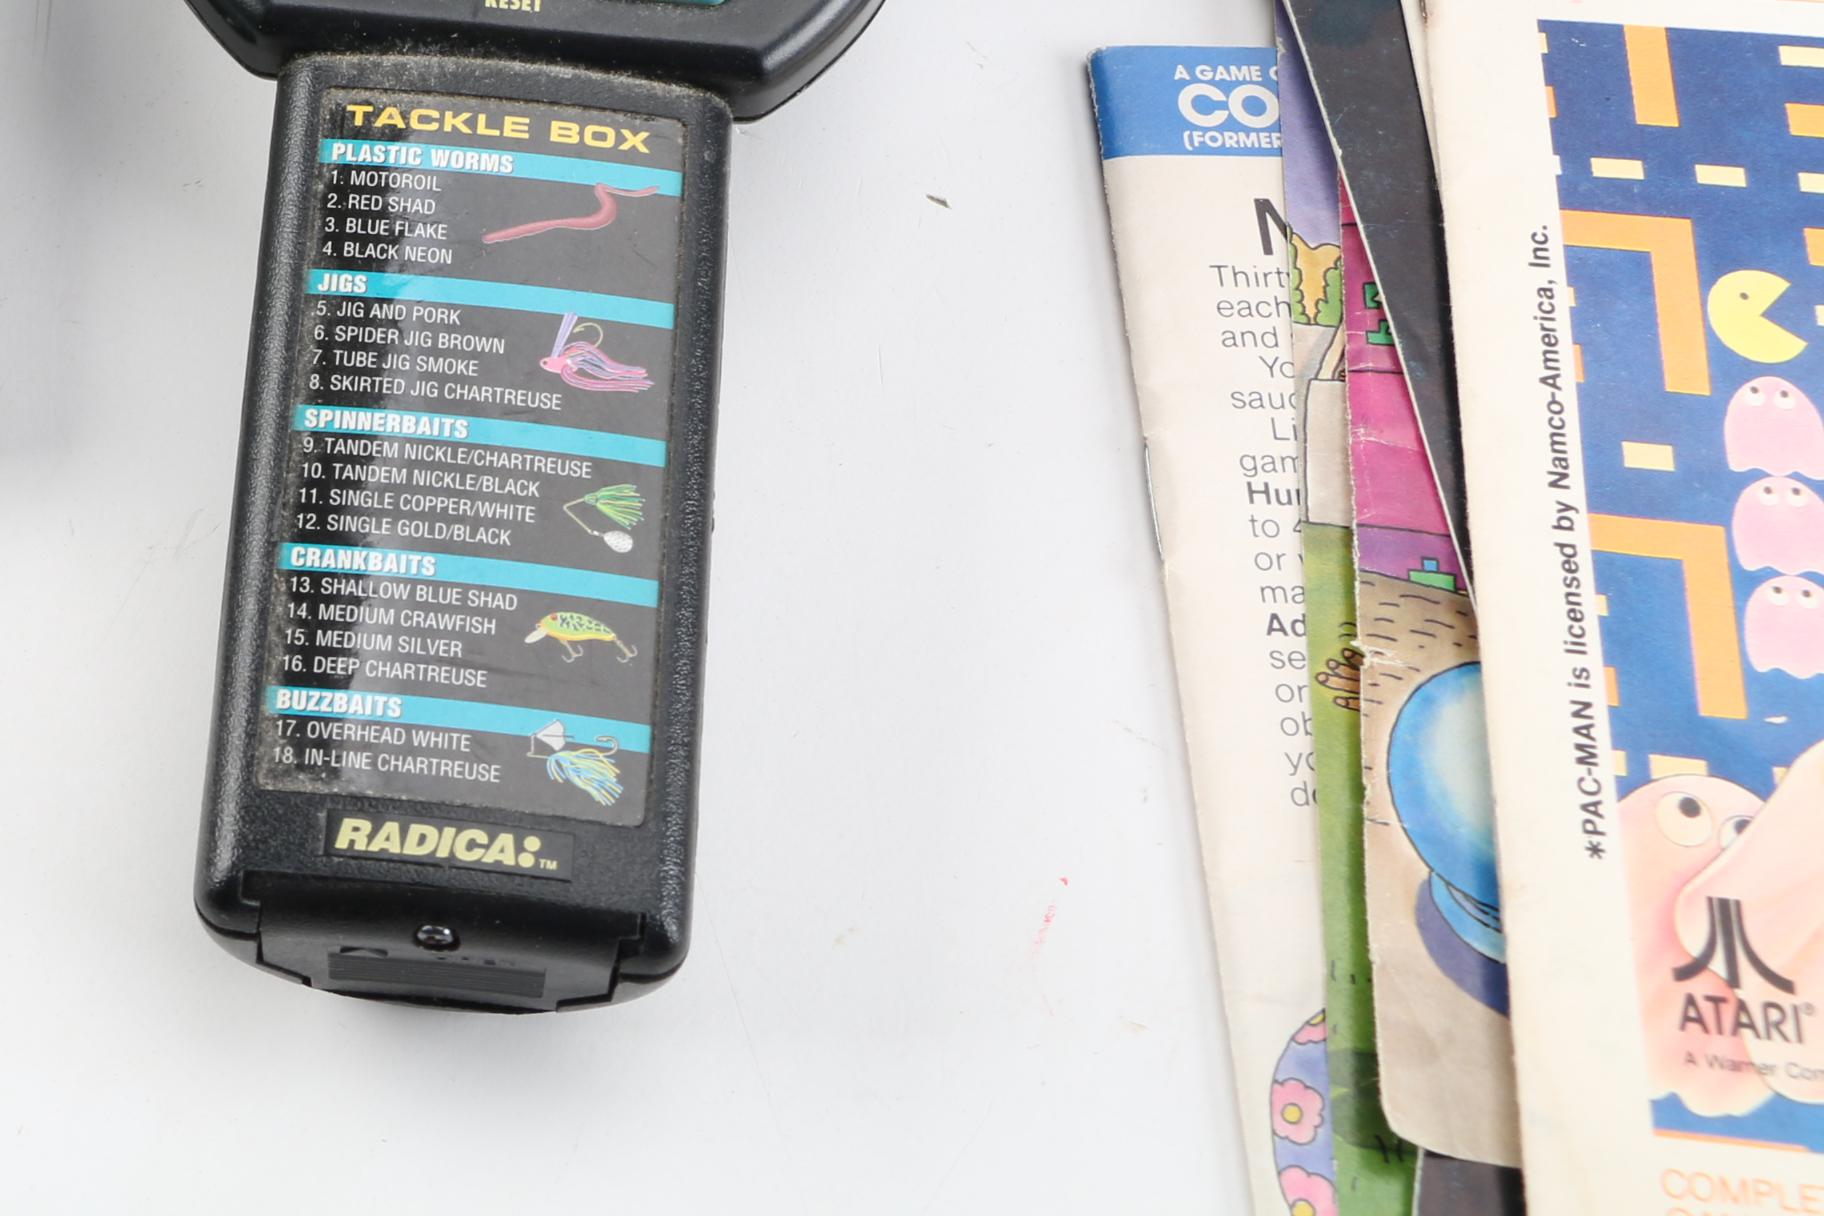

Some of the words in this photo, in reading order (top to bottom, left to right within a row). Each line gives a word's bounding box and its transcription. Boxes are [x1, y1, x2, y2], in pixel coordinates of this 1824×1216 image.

[1174, 65, 1190, 80] A
[1195, 65, 1262, 81] GAME
[346, 104, 530, 139] TACKLE
[550, 120, 650, 153] BOX
[332, 142, 422, 166] PLASTIC
[431, 149, 514, 173] WORMS
[350, 170, 442, 192] MOTOROIL
[348, 194, 383, 211] RED
[388, 197, 436, 214] SHAD
[345, 217, 389, 236] BLUE
[395, 221, 447, 240] FLAKE
[343, 242, 398, 260] BLACK
[405, 246, 453, 264] NEON
[1528, 225, 1551, 268] Inc.
[317, 273, 367, 294] JIGS
[337, 301, 365, 318] JIG
[370, 304, 407, 321] AND
[413, 307, 462, 325] PORK
[334, 326, 399, 345] SPIDER
[404, 330, 433, 349] JIG
[438, 332, 505, 354] BROWN
[1222, 326, 1279, 349] and
[333, 351, 378, 369] TUBE
[382, 354, 411, 371] JIG
[416, 356, 479, 376] SMOKE
[330, 375, 405, 395] SKIRTED
[410, 379, 438, 398] JIG
[444, 382, 562, 411] CHARTREUSE
[1534, 278, 1570, 491] Namco-America,
[304, 409, 468, 439] SPINNERBAITS
[325, 438, 399, 459] TANDEM
[404, 441, 592, 479] NICKLE/CHARTREUSE
[332, 463, 407, 485] TANDEM
[413, 468, 540, 497] NICKLE/BLACK
[329, 490, 393, 510] SINGLE
[400, 494, 536, 523] COPPER/WHITE
[1552, 500, 1579, 531] by
[327, 515, 391, 535] SINGLE
[398, 518, 512, 545] GOLD/BLACK
[291, 547, 436, 576] CRANKBAITS
[321, 578, 410, 601] SHALLOW
[416, 584, 462, 605] BLUE
[467, 589, 518, 611] SHAD
[1554, 543, 1588, 655] licensed
[318, 604, 394, 625] MEDIUM
[400, 609, 496, 635] CRAWFISH
[316, 630, 392, 652] MEDIUM
[398, 635, 462, 658] SILVER
[313, 657, 360, 676] DEEP
[365, 660, 487, 688] CHARTREUSE
[1568, 666, 1591, 689] is
[276, 690, 402, 718] BUZZBAITS
[307, 721, 406, 744] OVERHEAD
[412, 728, 472, 751] WHITE
[305, 748, 381, 770] IN-LINE
[378, 753, 501, 782] CHARTREUSE
